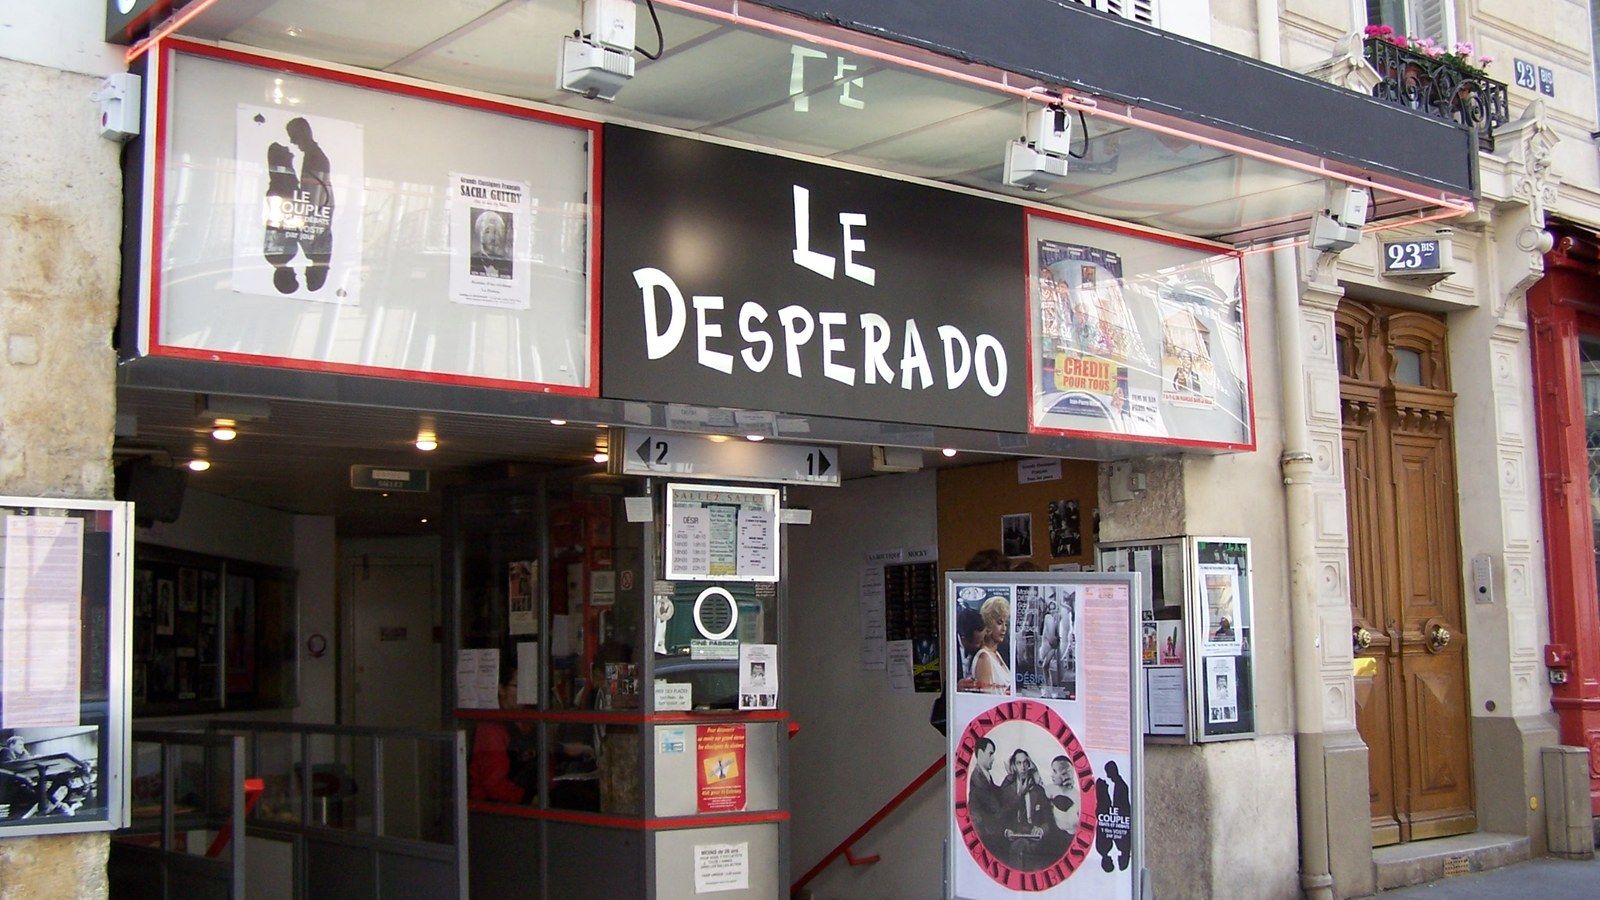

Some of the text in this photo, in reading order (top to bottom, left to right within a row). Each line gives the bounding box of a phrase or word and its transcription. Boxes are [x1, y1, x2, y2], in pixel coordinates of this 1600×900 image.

[1516, 60, 1553, 89] 23 BIS
[293, 190, 310, 203] LE
[460, 185, 487, 199] SACHA
[282, 201, 331, 218] OUPLE
[793, 184, 875, 286] LE
[1388, 242, 1435, 269] 23 BIS
[633, 267, 1008, 397] DESPERADO
[1063, 357, 1109, 380] CREDIT
[1063, 376, 1110, 392] POUR TOUS
[655, 441, 668, 466] 2
[806, 452, 814, 476] 1
[1056, 723, 1095, 794] TROIS
[1098, 813, 1130, 824] COUPLE
[1109, 806, 1118, 815] LE
[1019, 812, 1096, 892] LUBITSCH
